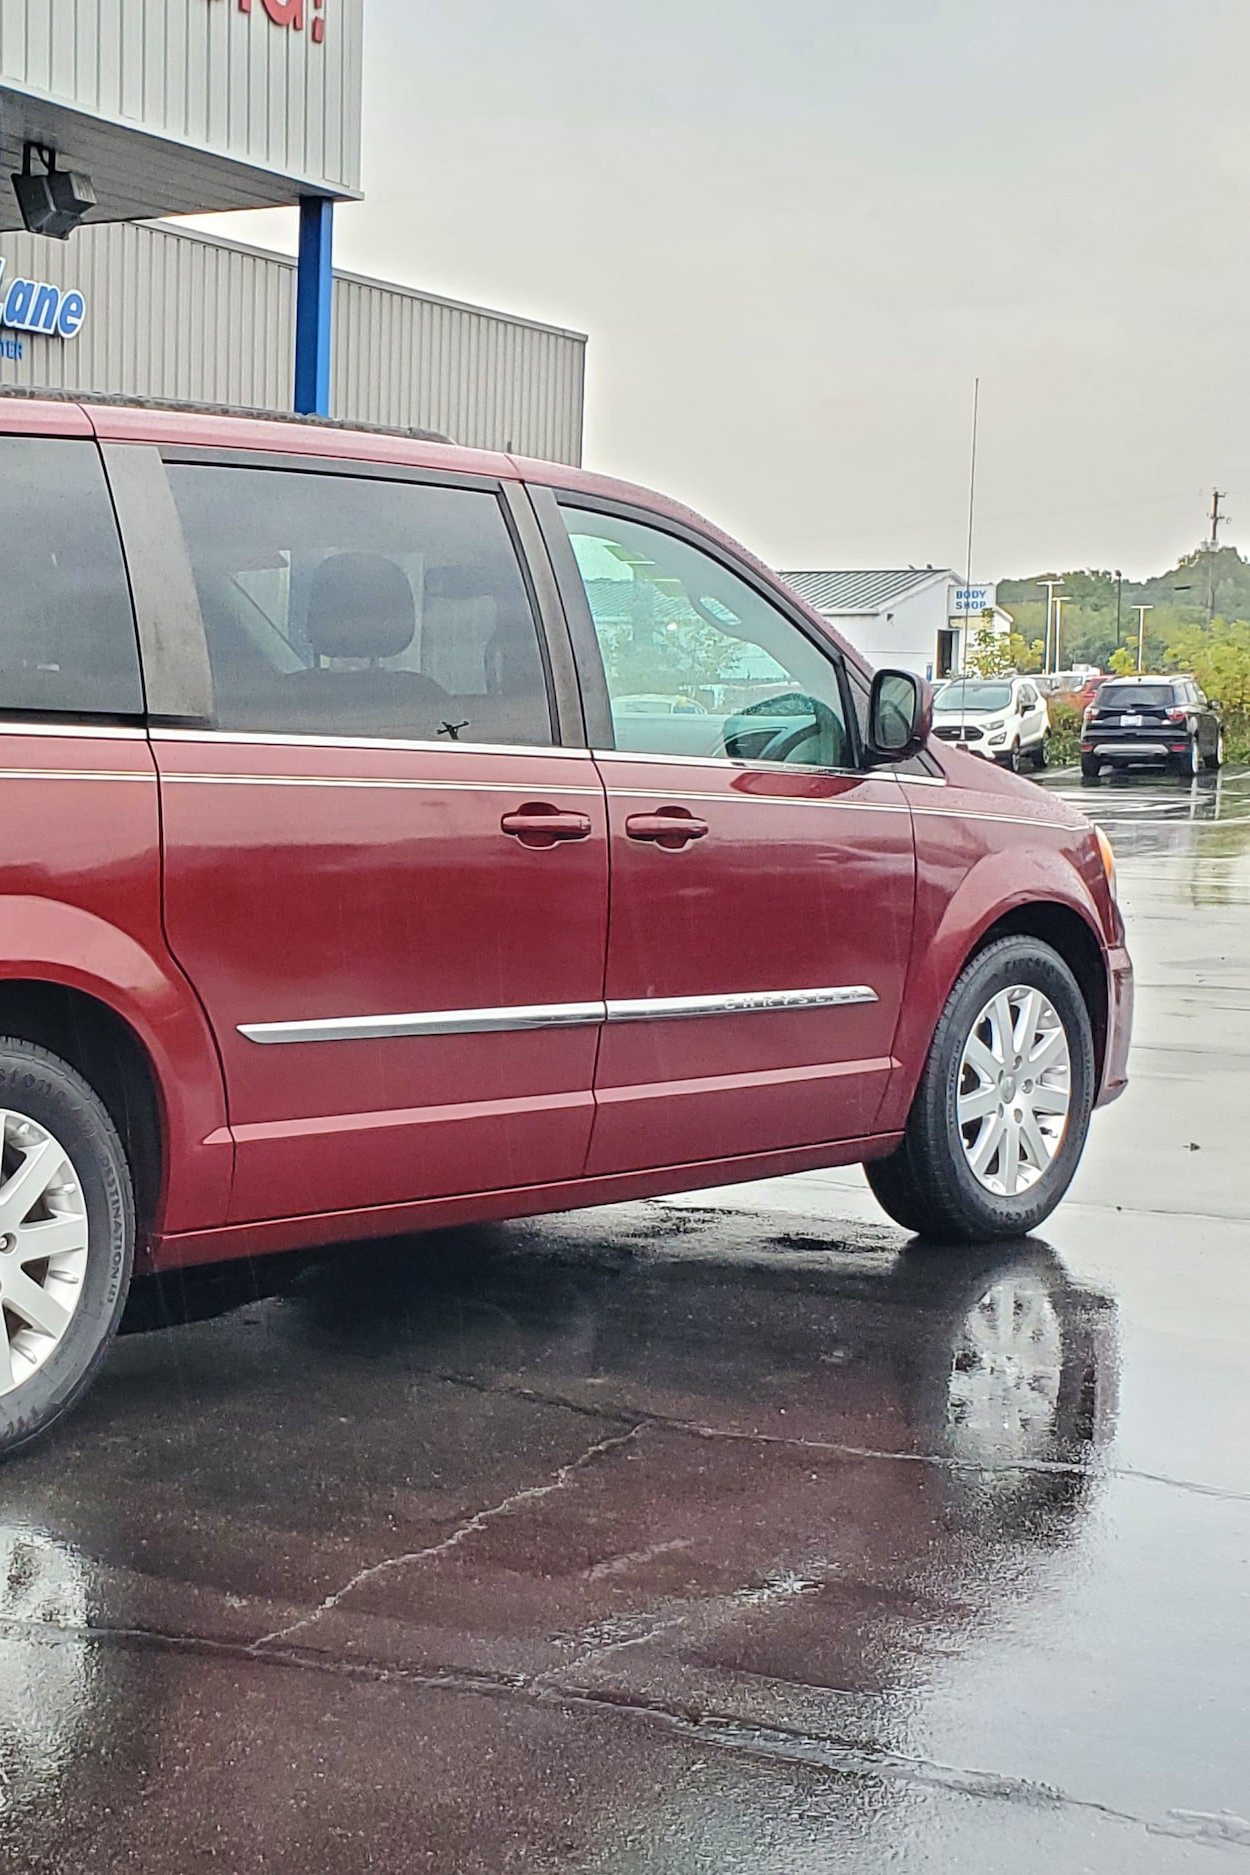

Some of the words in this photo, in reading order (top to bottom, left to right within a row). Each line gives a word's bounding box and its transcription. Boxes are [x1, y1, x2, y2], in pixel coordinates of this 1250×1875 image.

[955, 590, 987, 600] BODY
[955, 601, 986, 610] SHOP
[723, 989, 861, 1010] CHRYSLER
